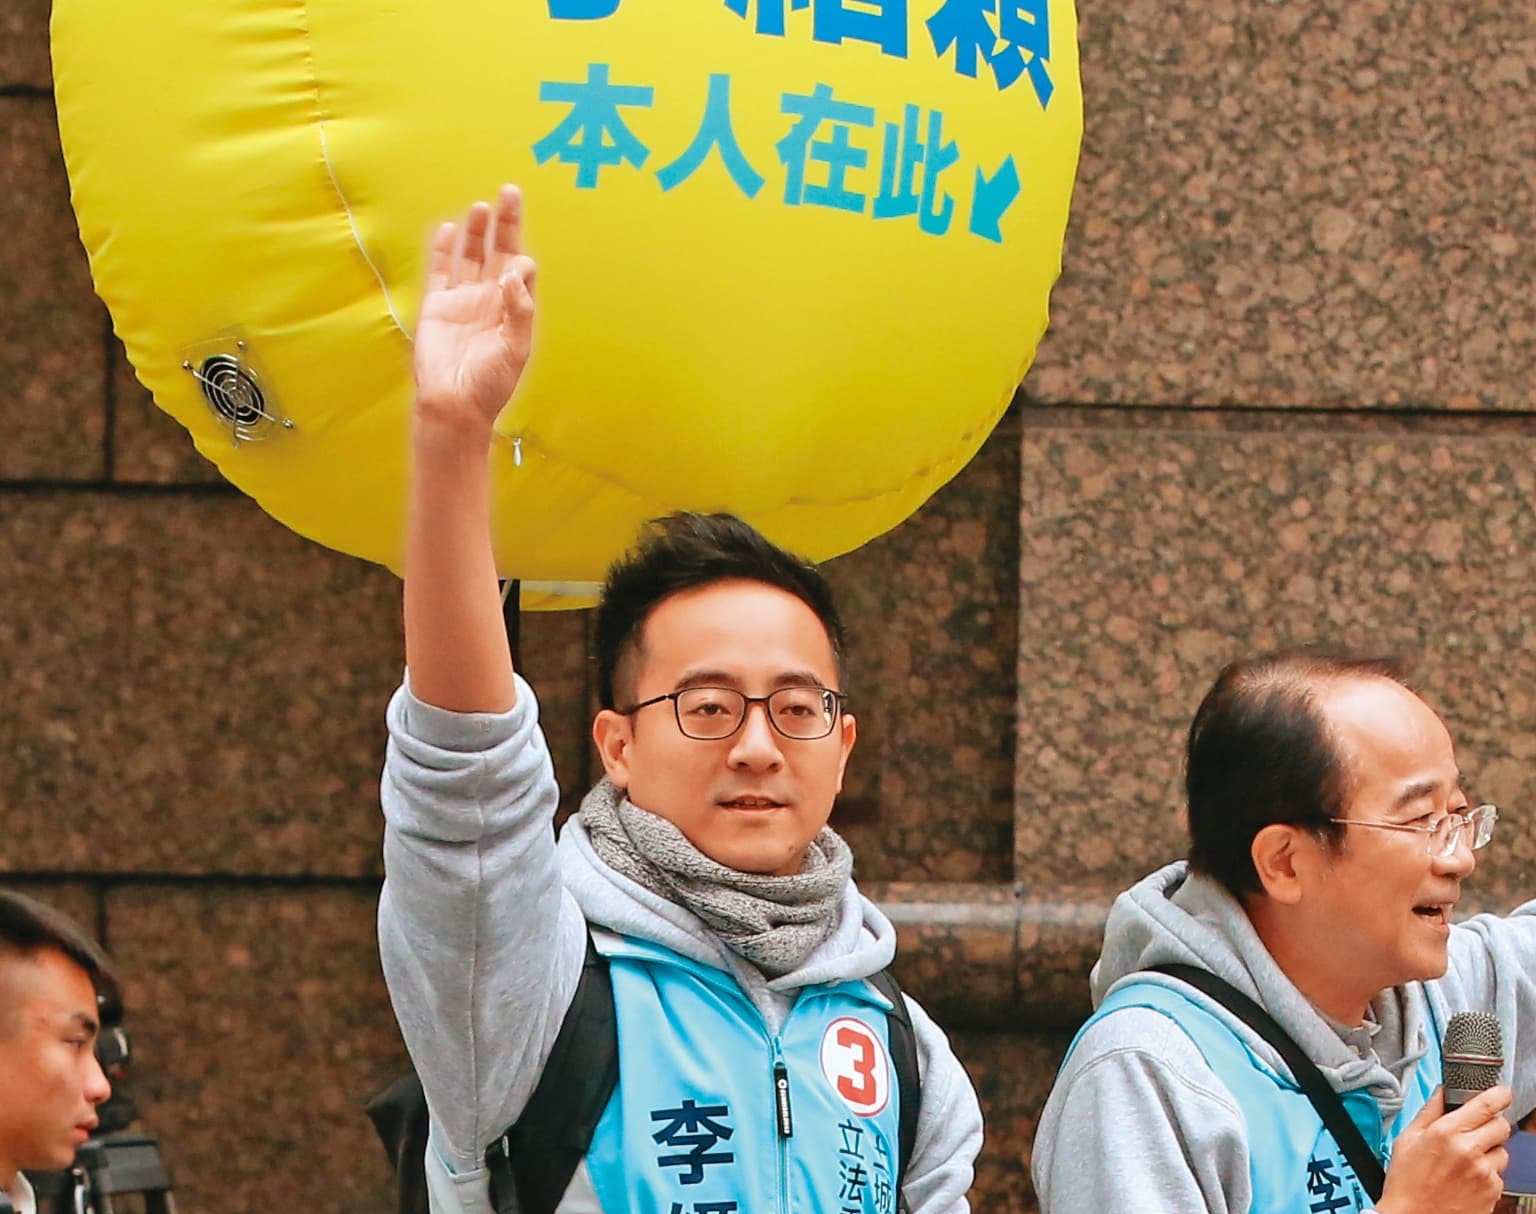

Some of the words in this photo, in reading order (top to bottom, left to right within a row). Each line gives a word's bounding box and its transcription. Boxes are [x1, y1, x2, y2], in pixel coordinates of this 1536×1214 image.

[532, 63, 959, 237] 本人在此
[837, 1027, 878, 1106] 3
